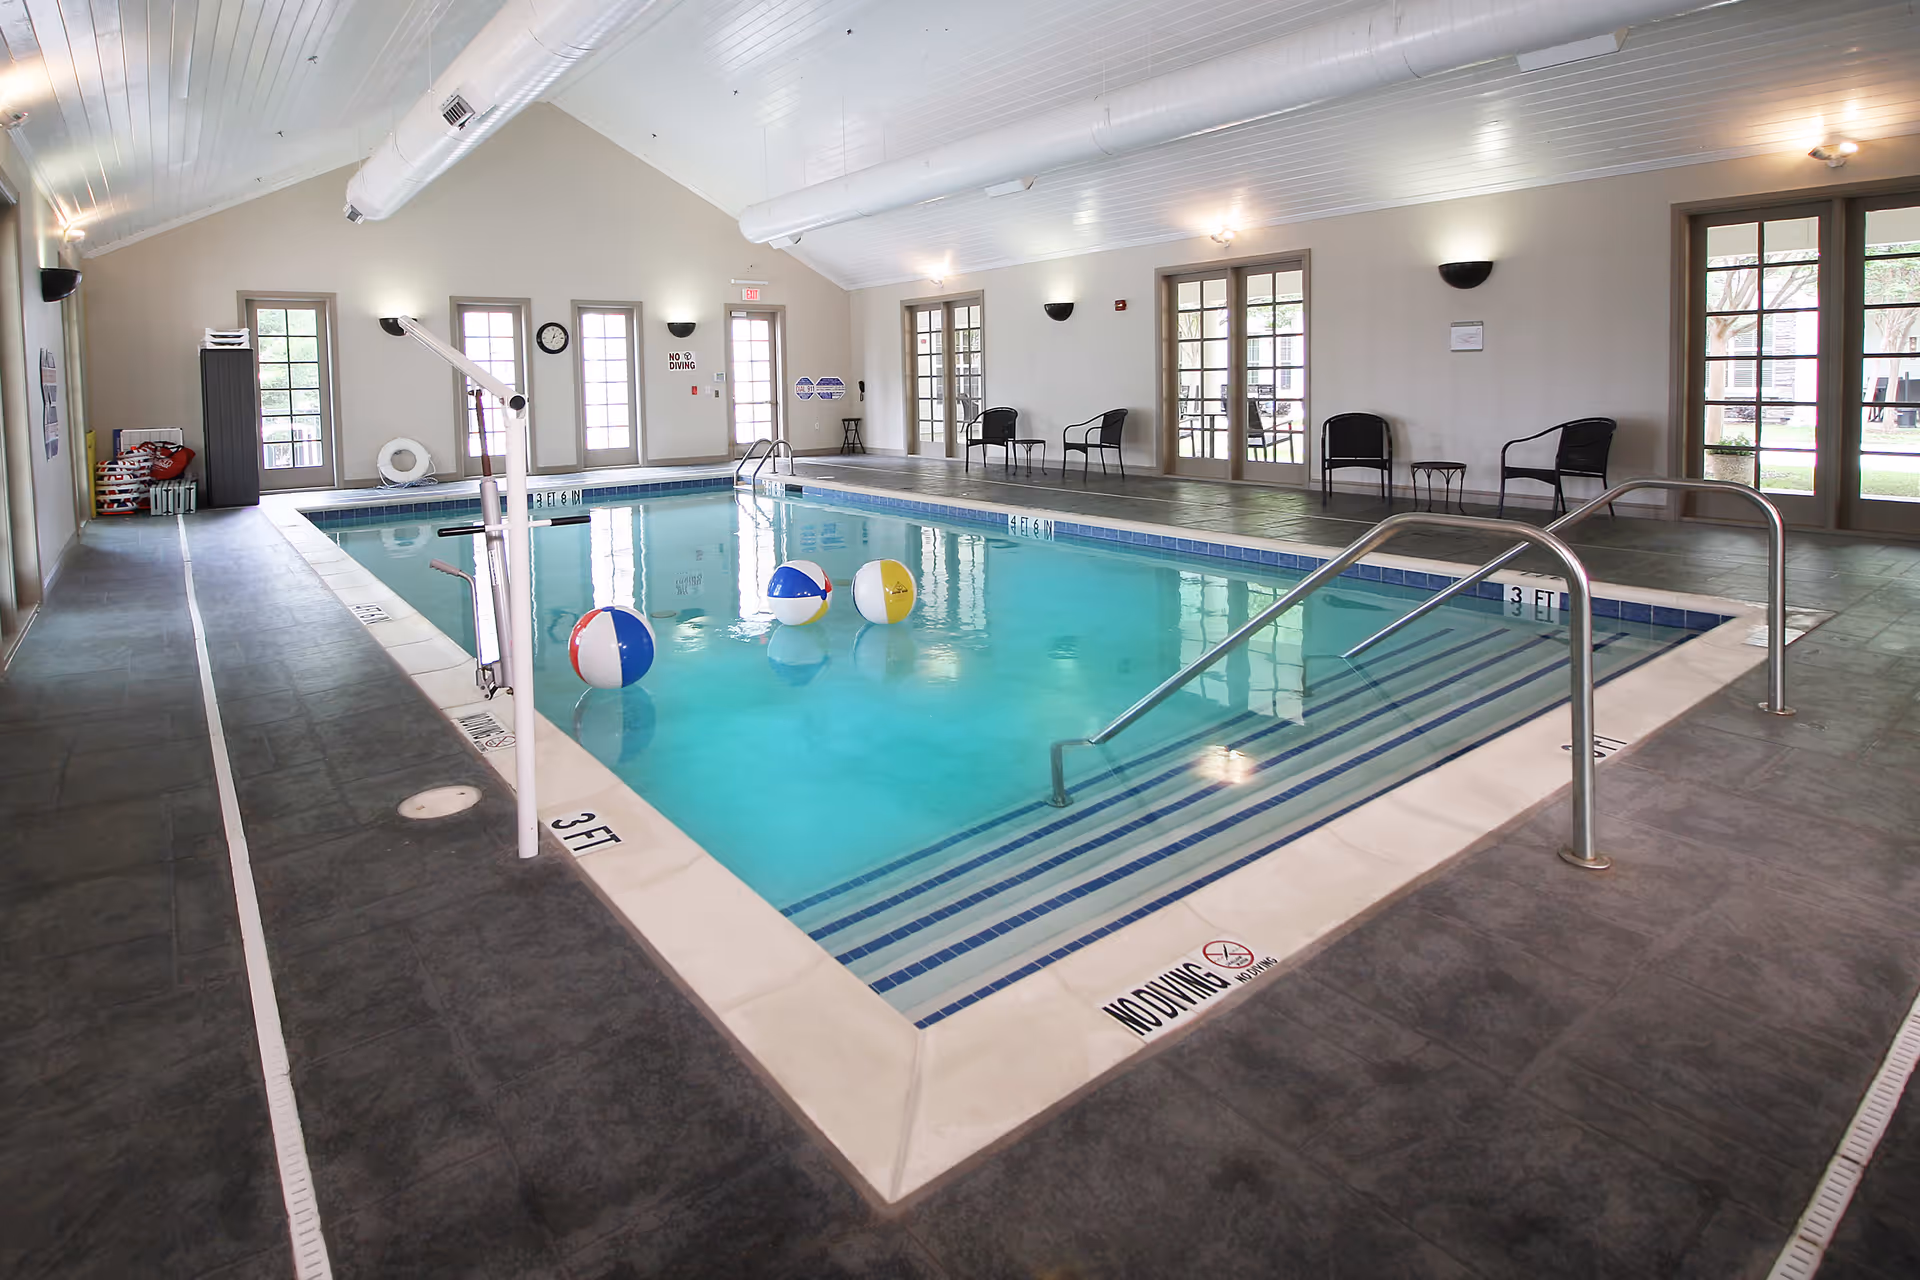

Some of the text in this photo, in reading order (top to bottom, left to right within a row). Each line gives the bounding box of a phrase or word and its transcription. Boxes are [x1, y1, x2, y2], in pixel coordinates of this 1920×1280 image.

[746, 289, 758, 300] EXIT
[669, 352, 680, 361] NO
[669, 361, 696, 370] DIVING
[1511, 586, 1555, 607] 3 FT
[460, 718, 506, 740] DIVING
[551, 813, 622, 852] 3 FT
[1234, 971, 1253, 983] NO
[1246, 956, 1278, 976] DIVING
[1102, 962, 1232, 1036] NO DIVING
